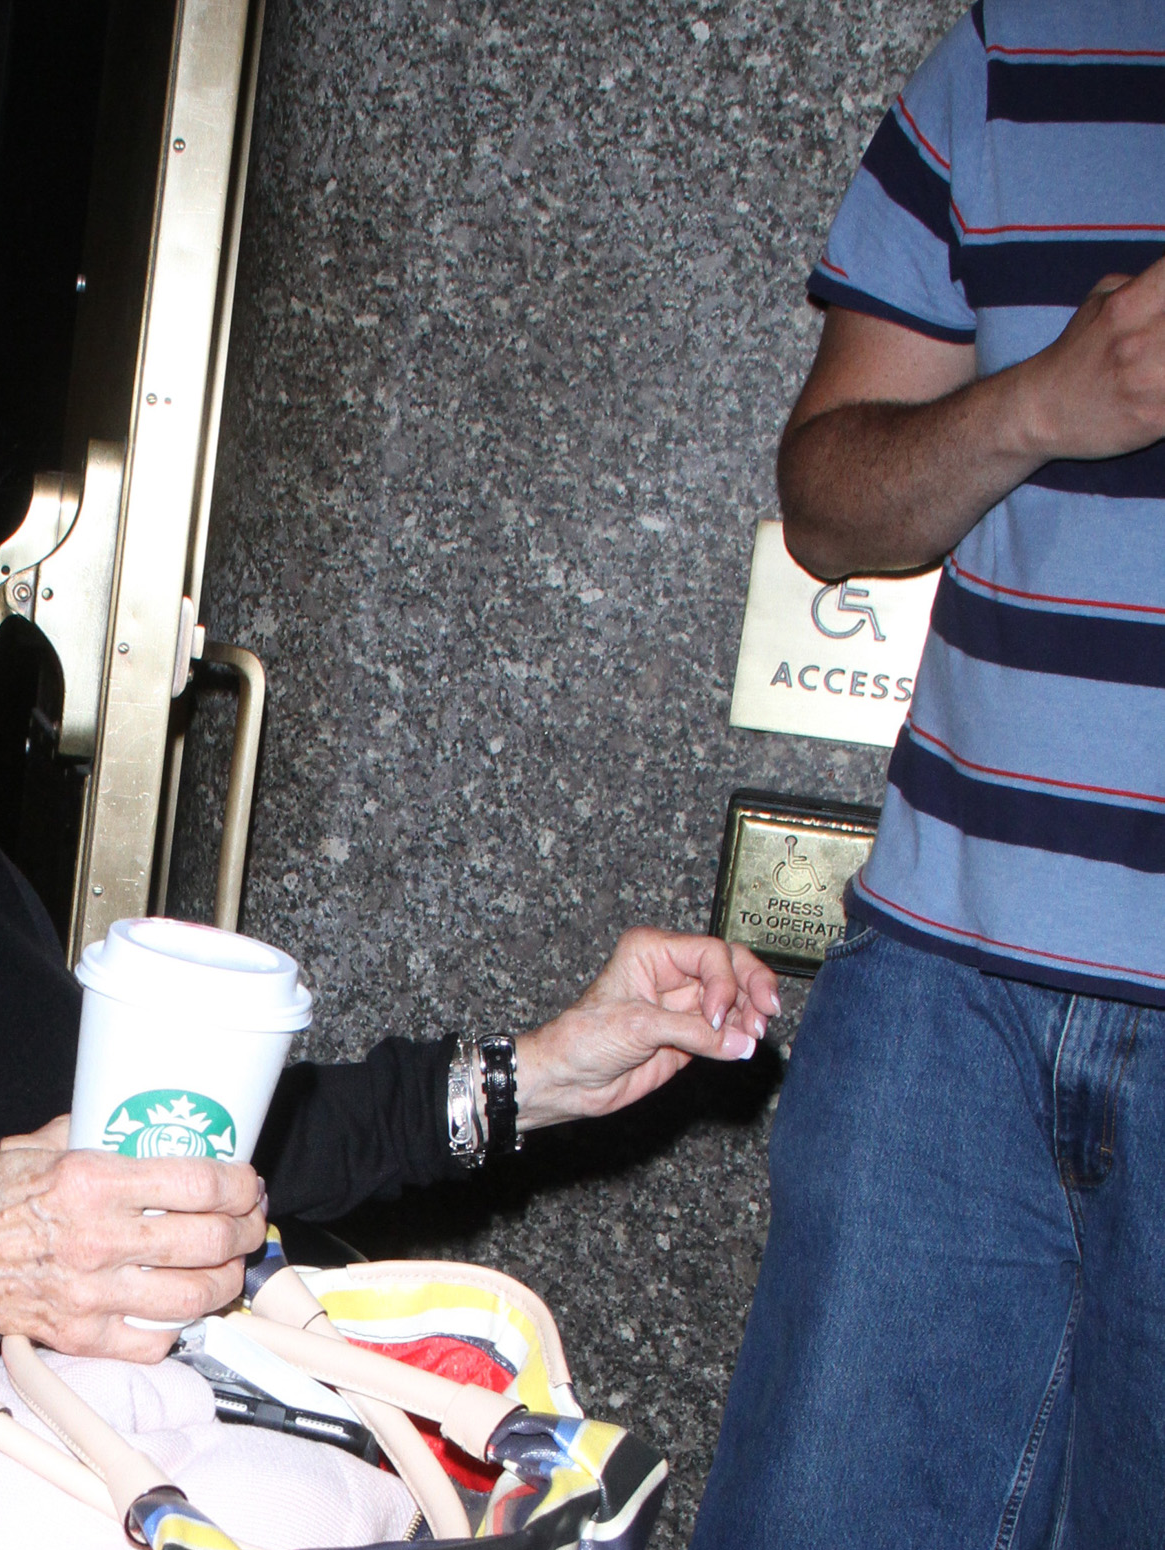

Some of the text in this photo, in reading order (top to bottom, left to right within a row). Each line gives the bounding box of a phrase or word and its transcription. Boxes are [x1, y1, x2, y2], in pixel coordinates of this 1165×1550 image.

[771, 661, 912, 701] ACCESS
[767, 897, 824, 917] PRESS
[739, 911, 846, 938] TO OPERATE
[765, 932, 817, 951] DOOR
